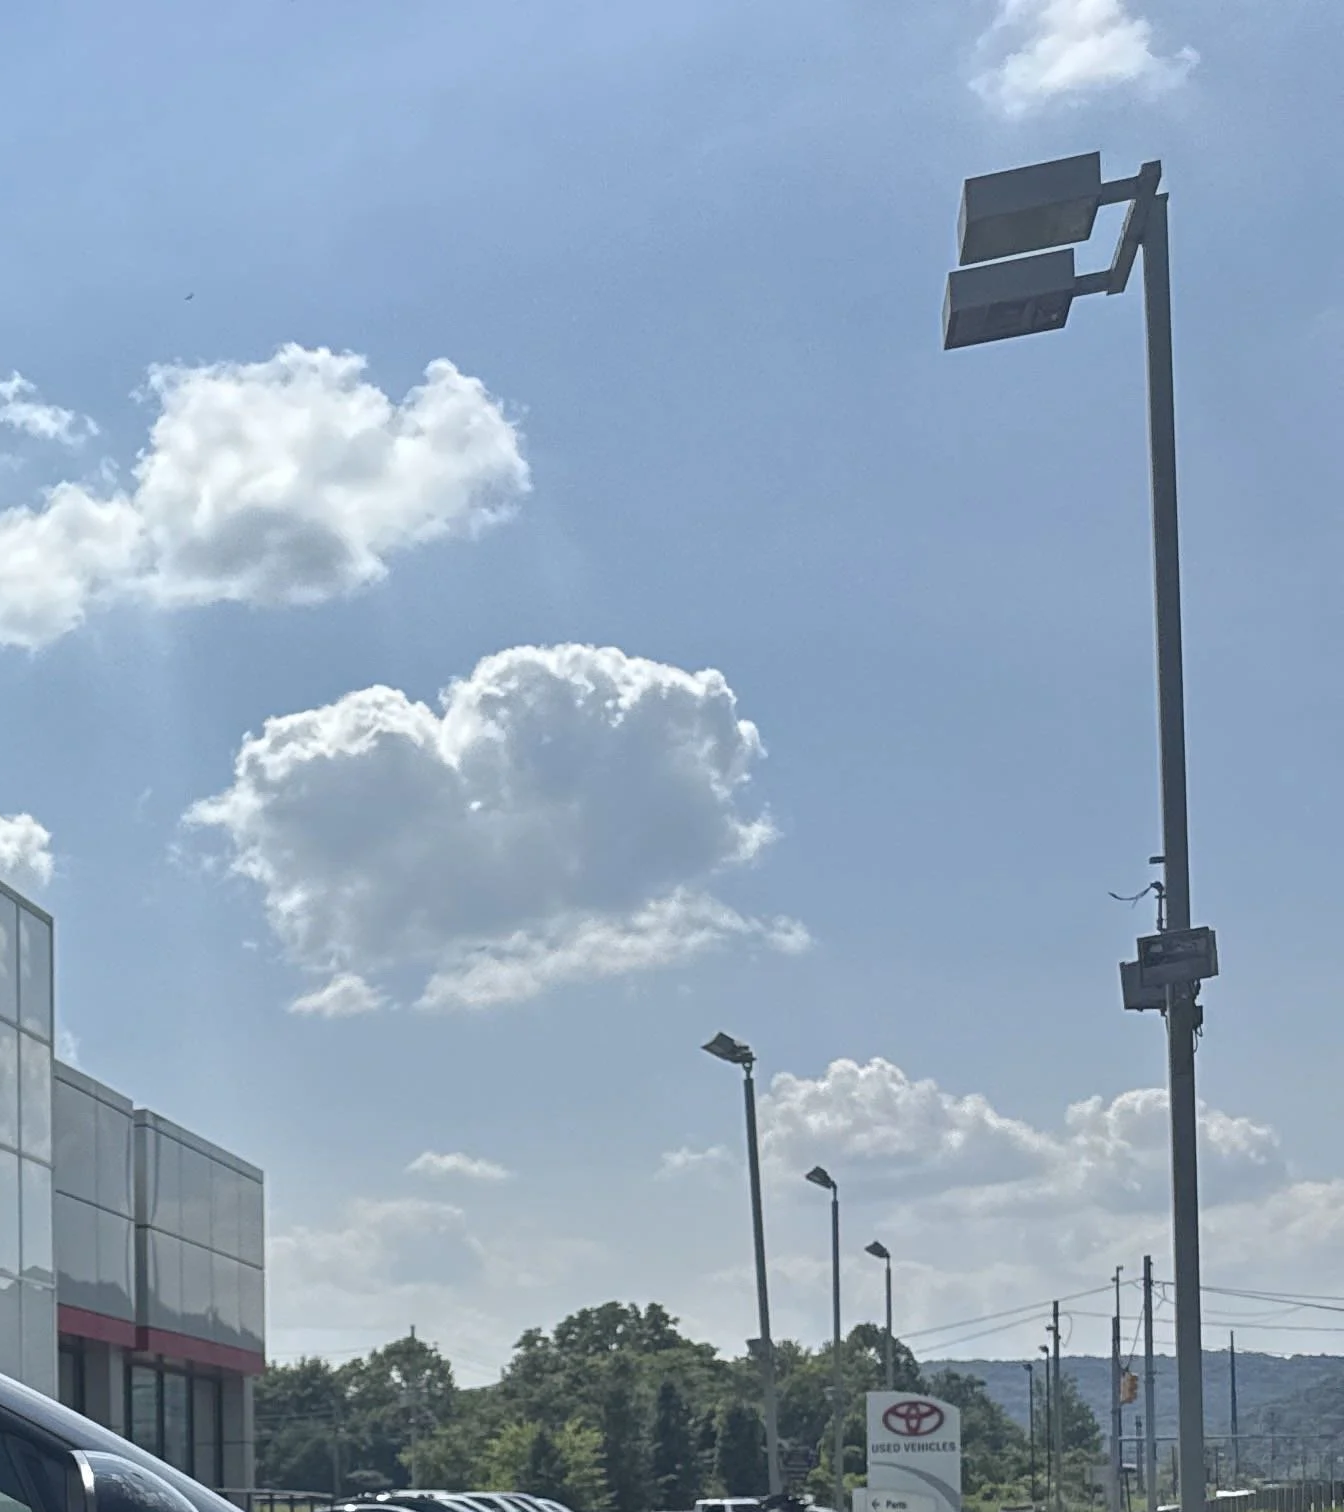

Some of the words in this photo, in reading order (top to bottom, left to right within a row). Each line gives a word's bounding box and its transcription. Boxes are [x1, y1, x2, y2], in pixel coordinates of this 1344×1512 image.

[871, 1442, 901, 1454] USED
[904, 1441, 957, 1453] VEHICLES
[886, 1500, 908, 1510] Parts
